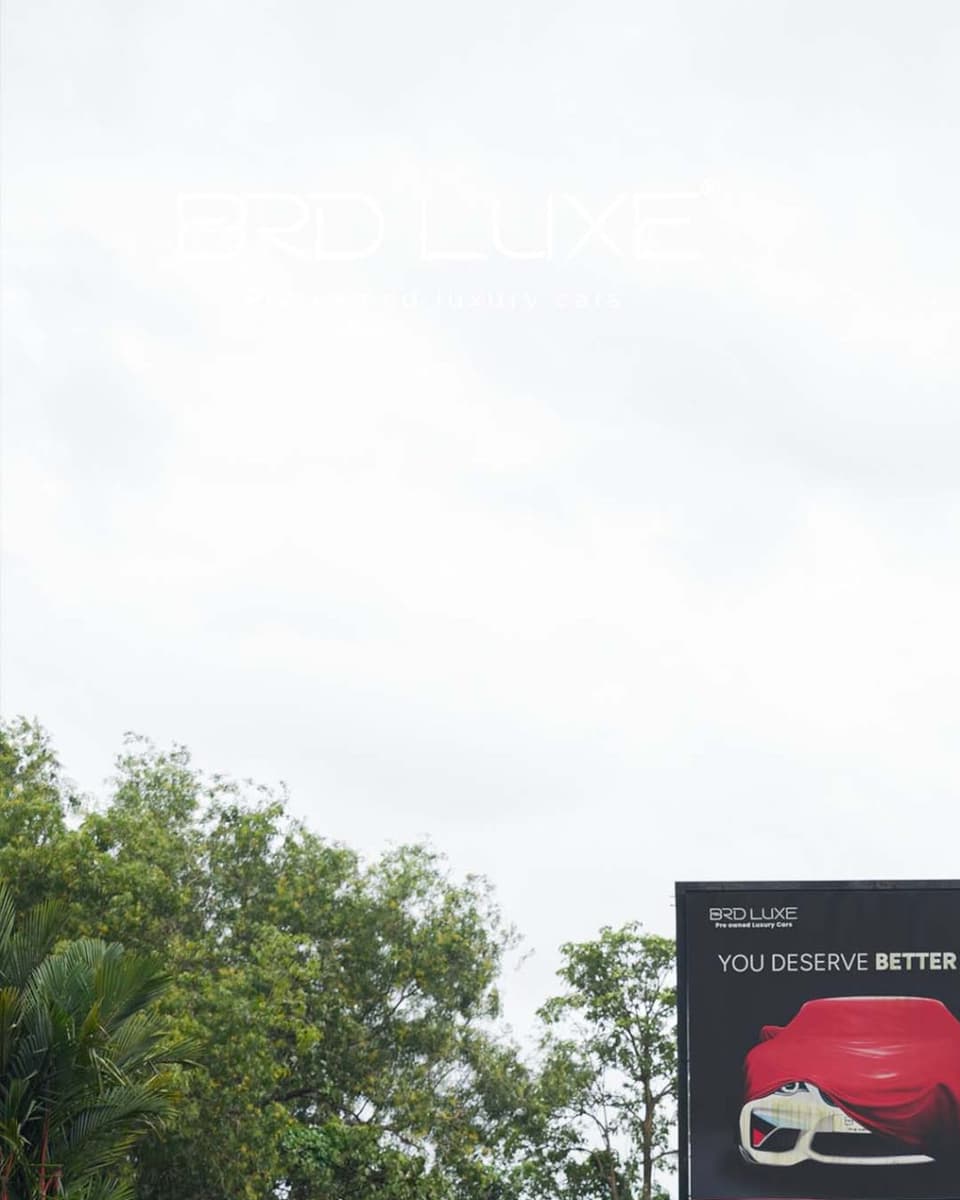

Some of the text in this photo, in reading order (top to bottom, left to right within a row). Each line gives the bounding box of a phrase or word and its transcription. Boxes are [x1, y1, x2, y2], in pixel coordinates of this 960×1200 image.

[709, 906, 798, 921] BRD LUXE
[752, 921, 775, 930] Luxury
[718, 953, 765, 973] YOU
[772, 952, 868, 972] DESERVE
[875, 952, 957, 970] BETTER
